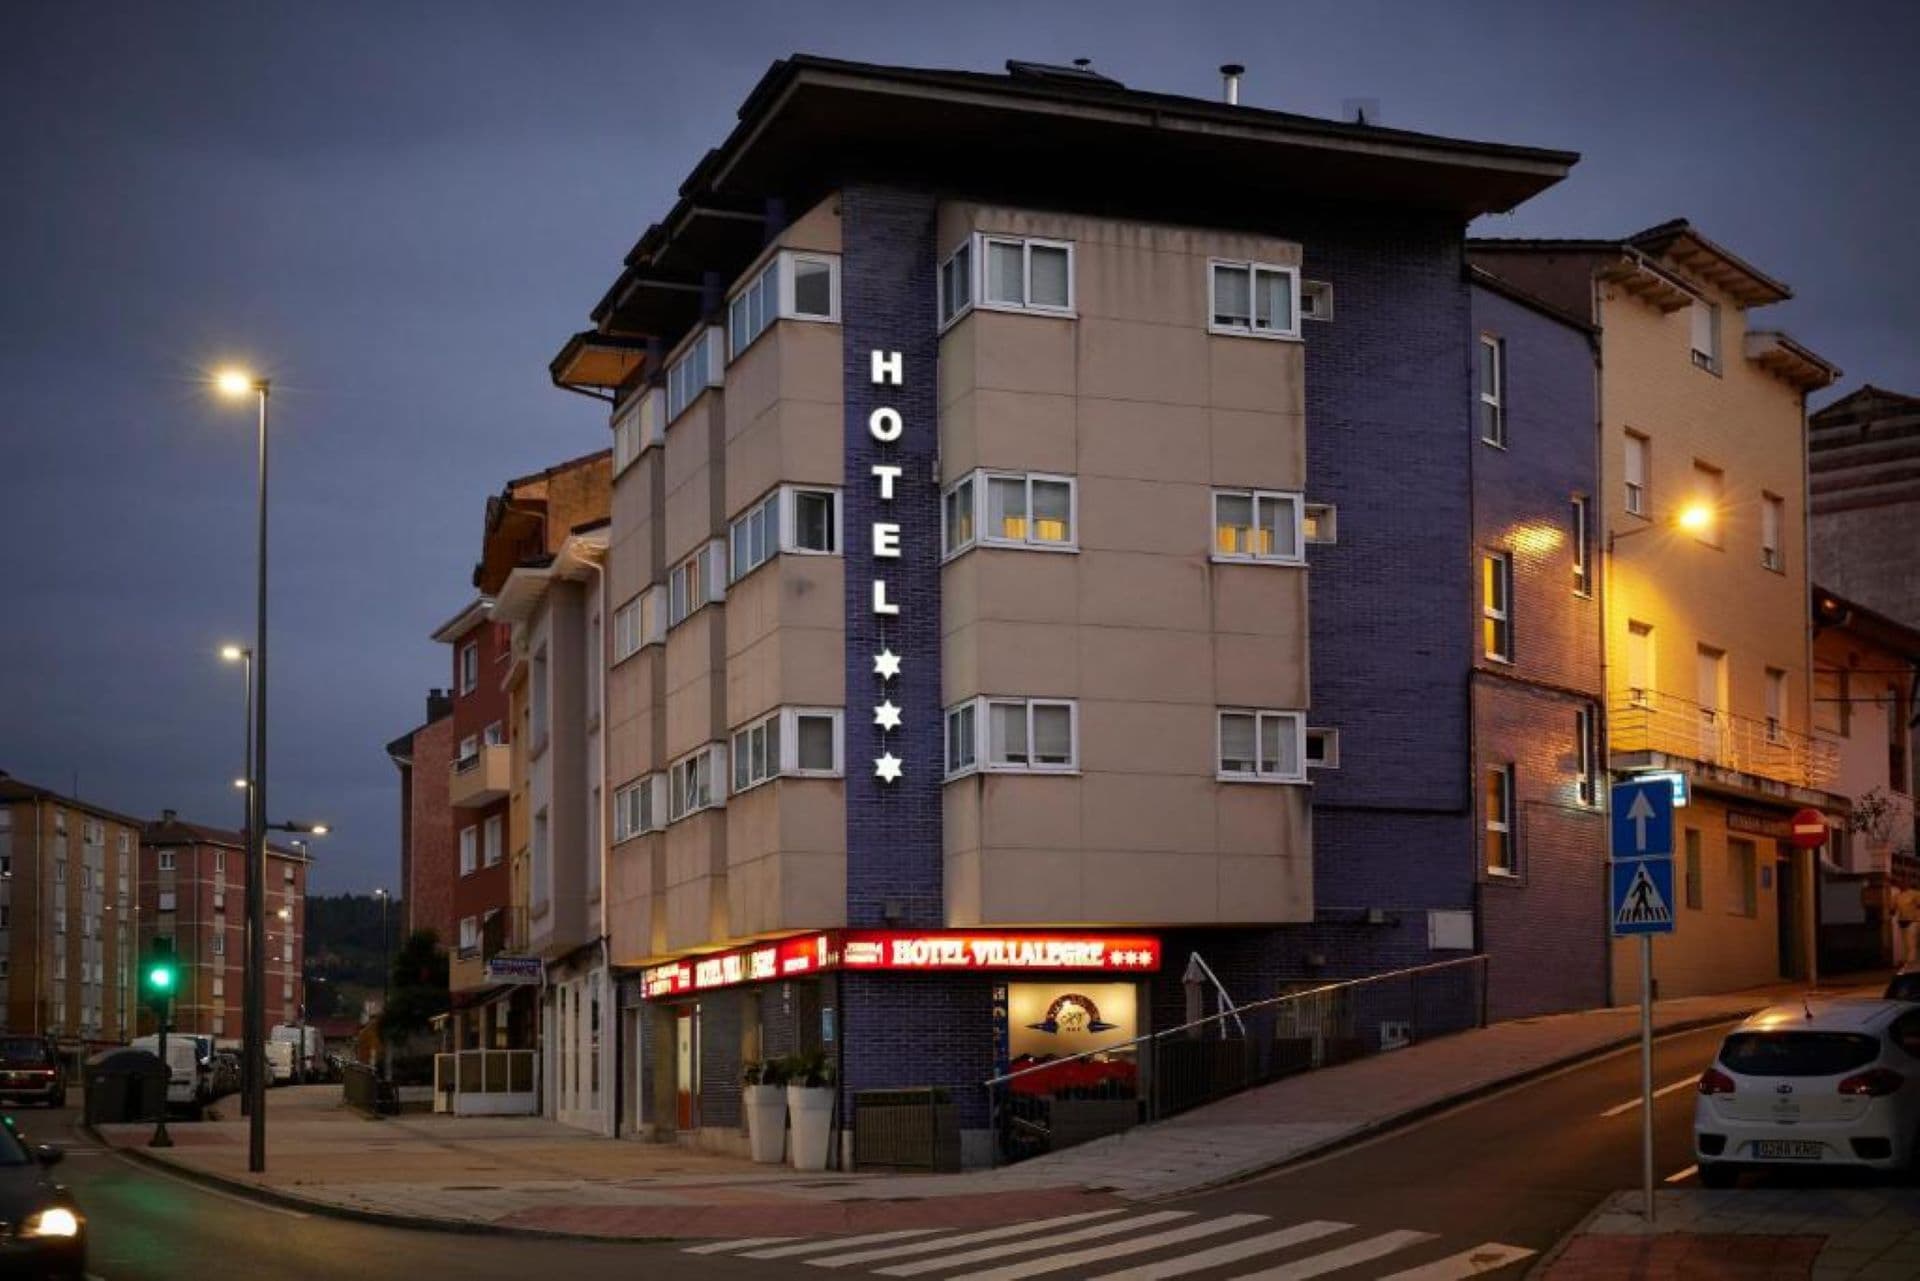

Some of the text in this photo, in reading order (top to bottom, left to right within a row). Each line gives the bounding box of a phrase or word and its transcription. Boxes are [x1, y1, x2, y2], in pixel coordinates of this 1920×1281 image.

[869, 350, 904, 615] HOTEL
[892, 940, 970, 965] HOTEL
[971, 941, 1105, 966] VILLALEGRE
